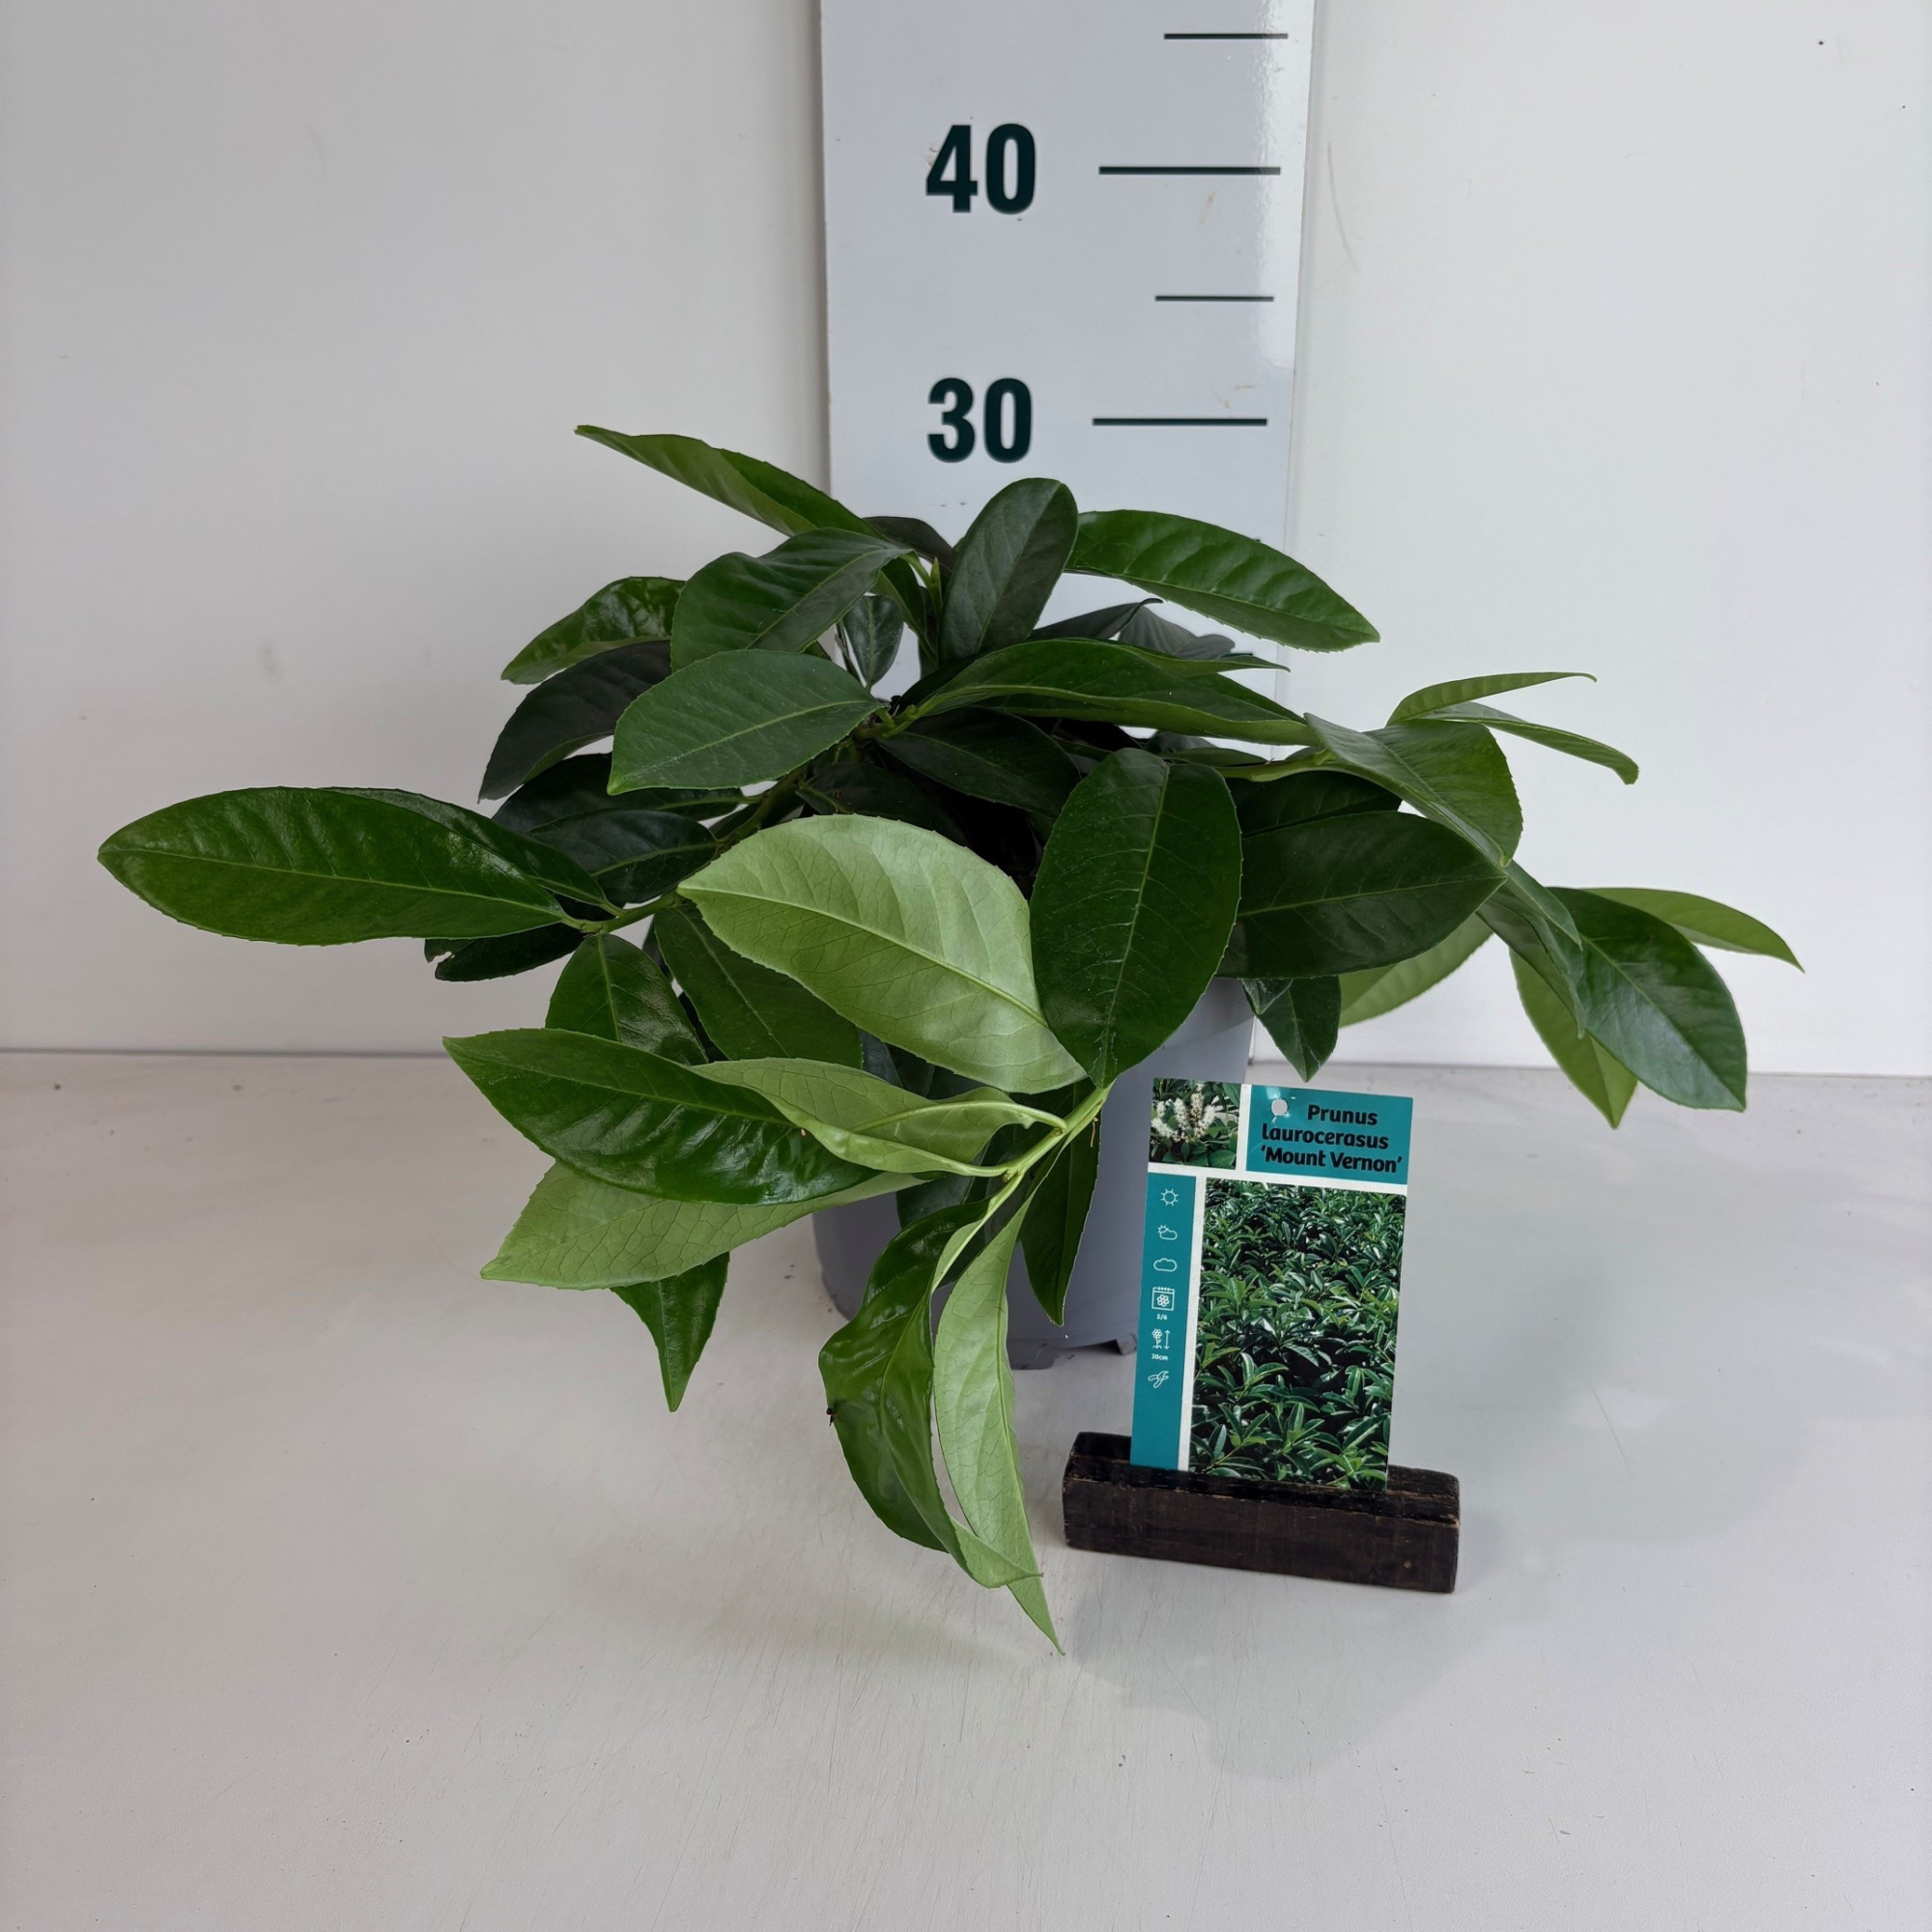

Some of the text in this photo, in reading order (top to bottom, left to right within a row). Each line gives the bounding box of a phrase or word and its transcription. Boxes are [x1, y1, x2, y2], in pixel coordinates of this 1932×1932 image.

[925, 123, 1037, 215] 40
[927, 377, 1033, 464] 30
[1307, 1103, 1378, 1126] Prunus
[1261, 1122, 1389, 1151] laurocerasus
[1151, 1352, 1169, 1361] 30cm
